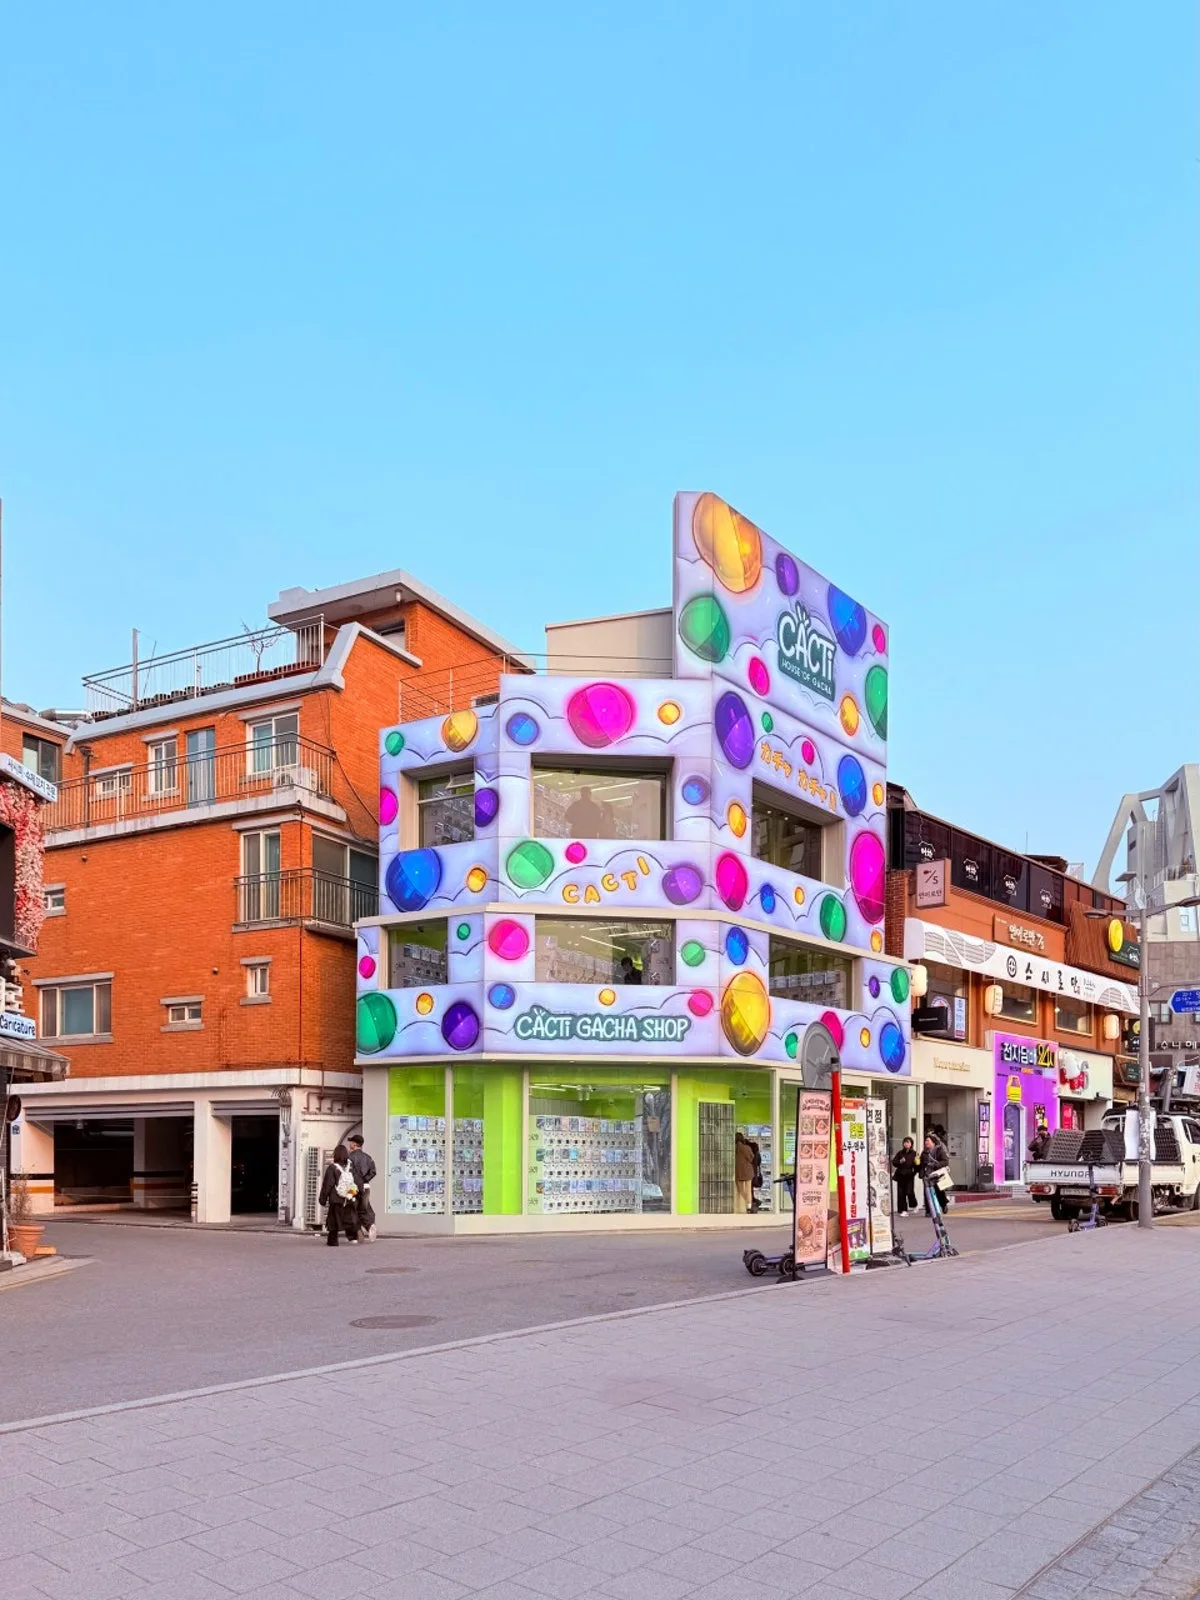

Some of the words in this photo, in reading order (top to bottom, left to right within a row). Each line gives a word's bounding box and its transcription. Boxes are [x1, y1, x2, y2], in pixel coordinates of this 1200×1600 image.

[782, 659, 801, 677] HOUSE
[801, 671, 811, 682] OF
[562, 856, 650, 904] CACTI
[0, 1015, 35, 1036] Caricature
[576, 1017, 638, 1039] GACHA
[642, 1018, 689, 1039] SHOP
